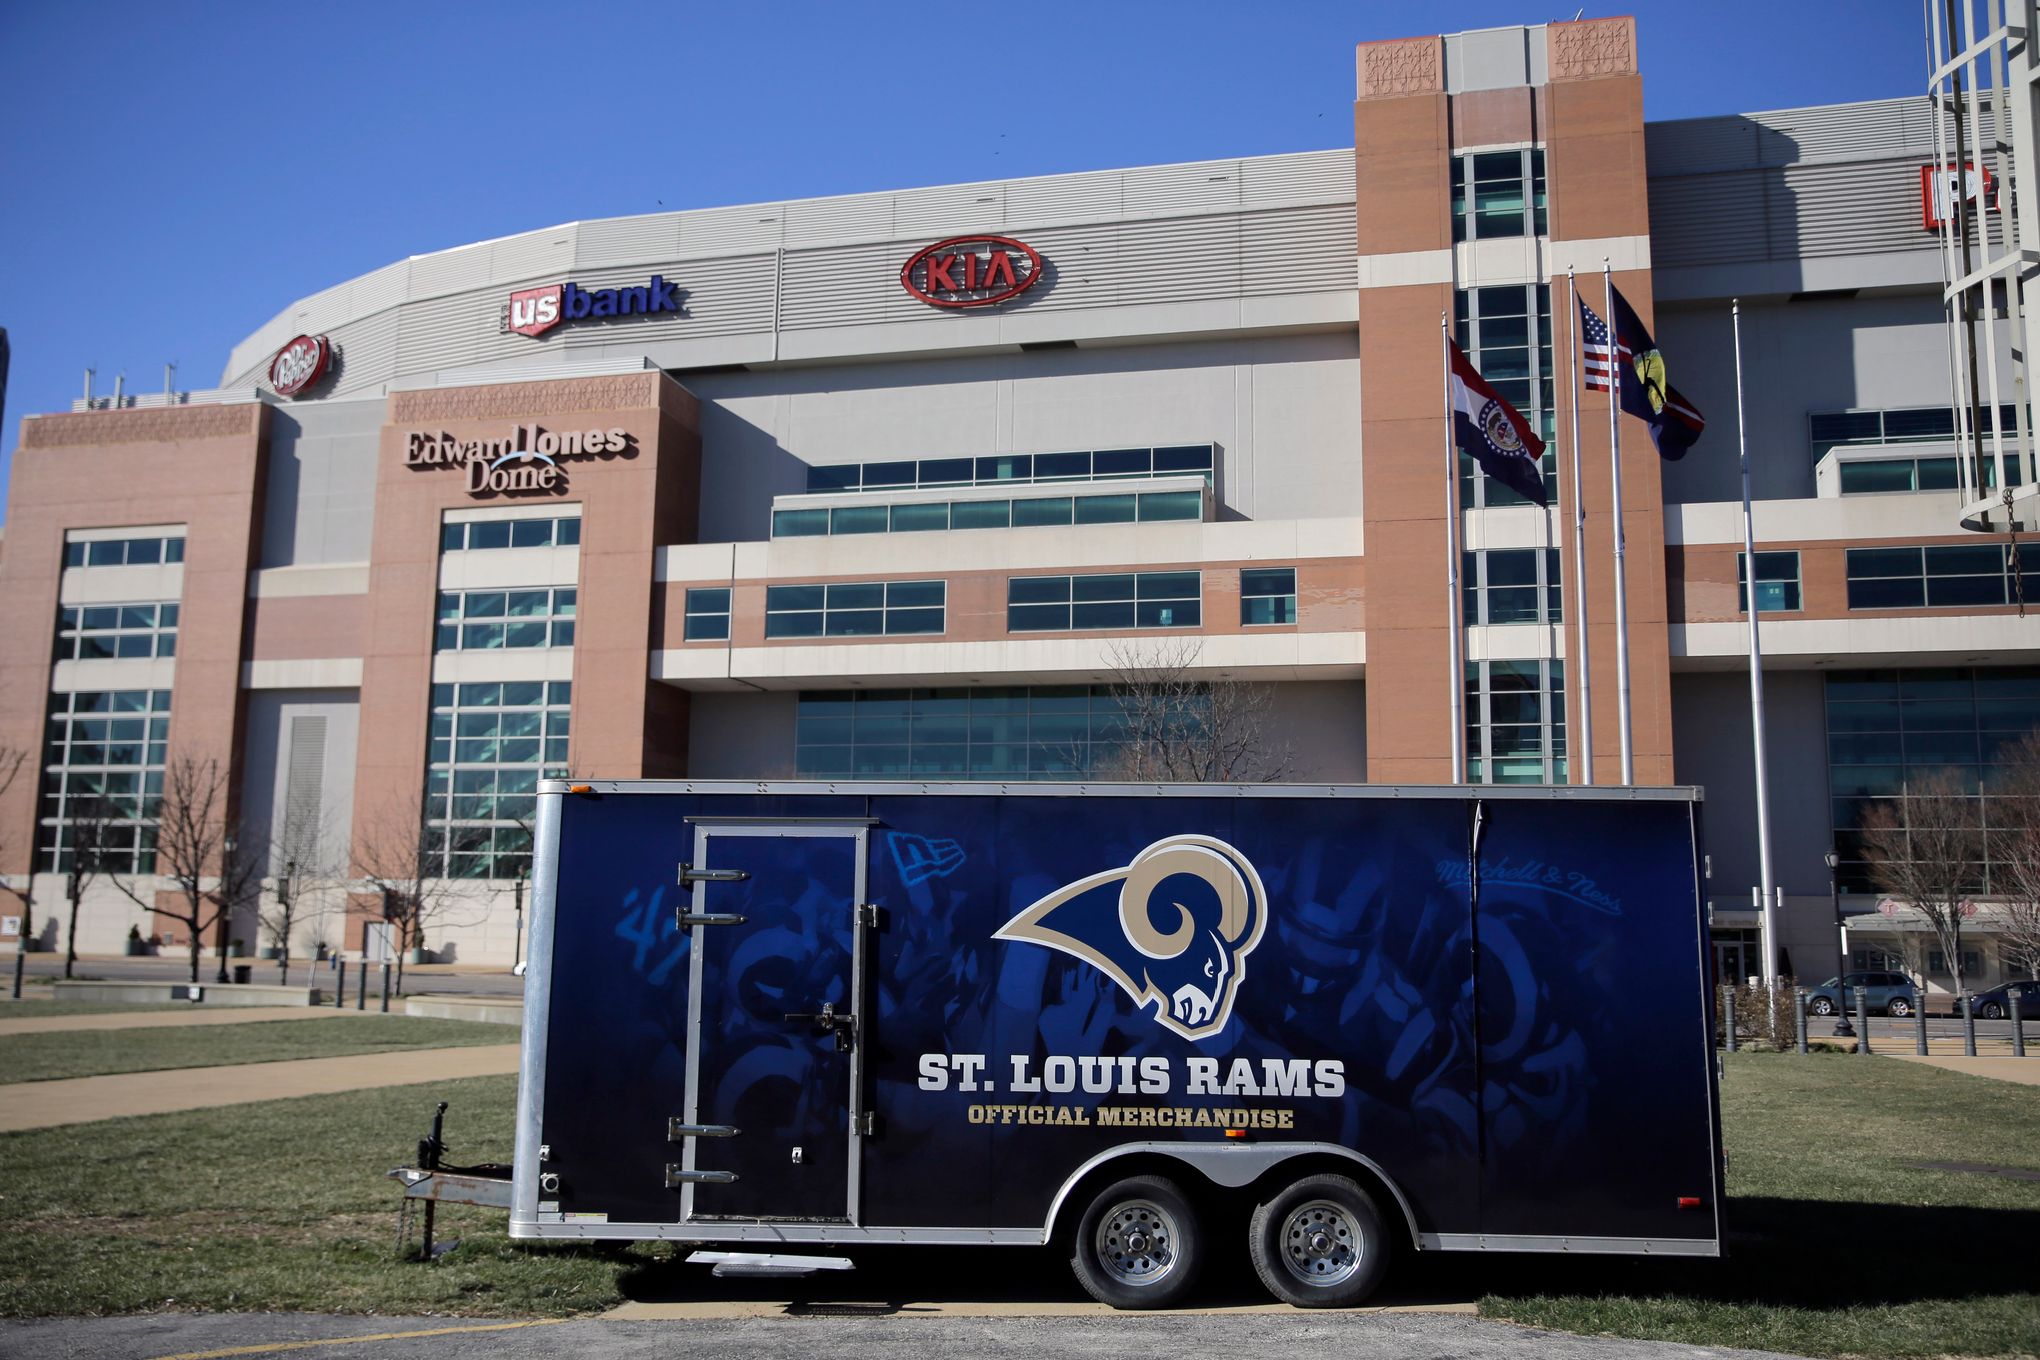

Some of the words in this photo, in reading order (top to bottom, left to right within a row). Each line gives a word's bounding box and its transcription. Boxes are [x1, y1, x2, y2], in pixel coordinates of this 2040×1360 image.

[926, 251, 1016, 294] KIA
[512, 295, 558, 328] us
[564, 275, 680, 320] bank
[403, 424, 520, 465] Edward
[521, 423, 627, 463] Jones
[464, 459, 557, 494] Dome
[1542, 866, 1564, 884] &
[1567, 871, 1622, 912] Ness
[918, 1054, 994, 1092] ST.
[1010, 1055, 1170, 1094] LOUIS
[1187, 1058, 1345, 1097] RAMS
[968, 1104, 1090, 1126] OFFICIAL
[1097, 1106, 1294, 1129] MERCHANDISE
